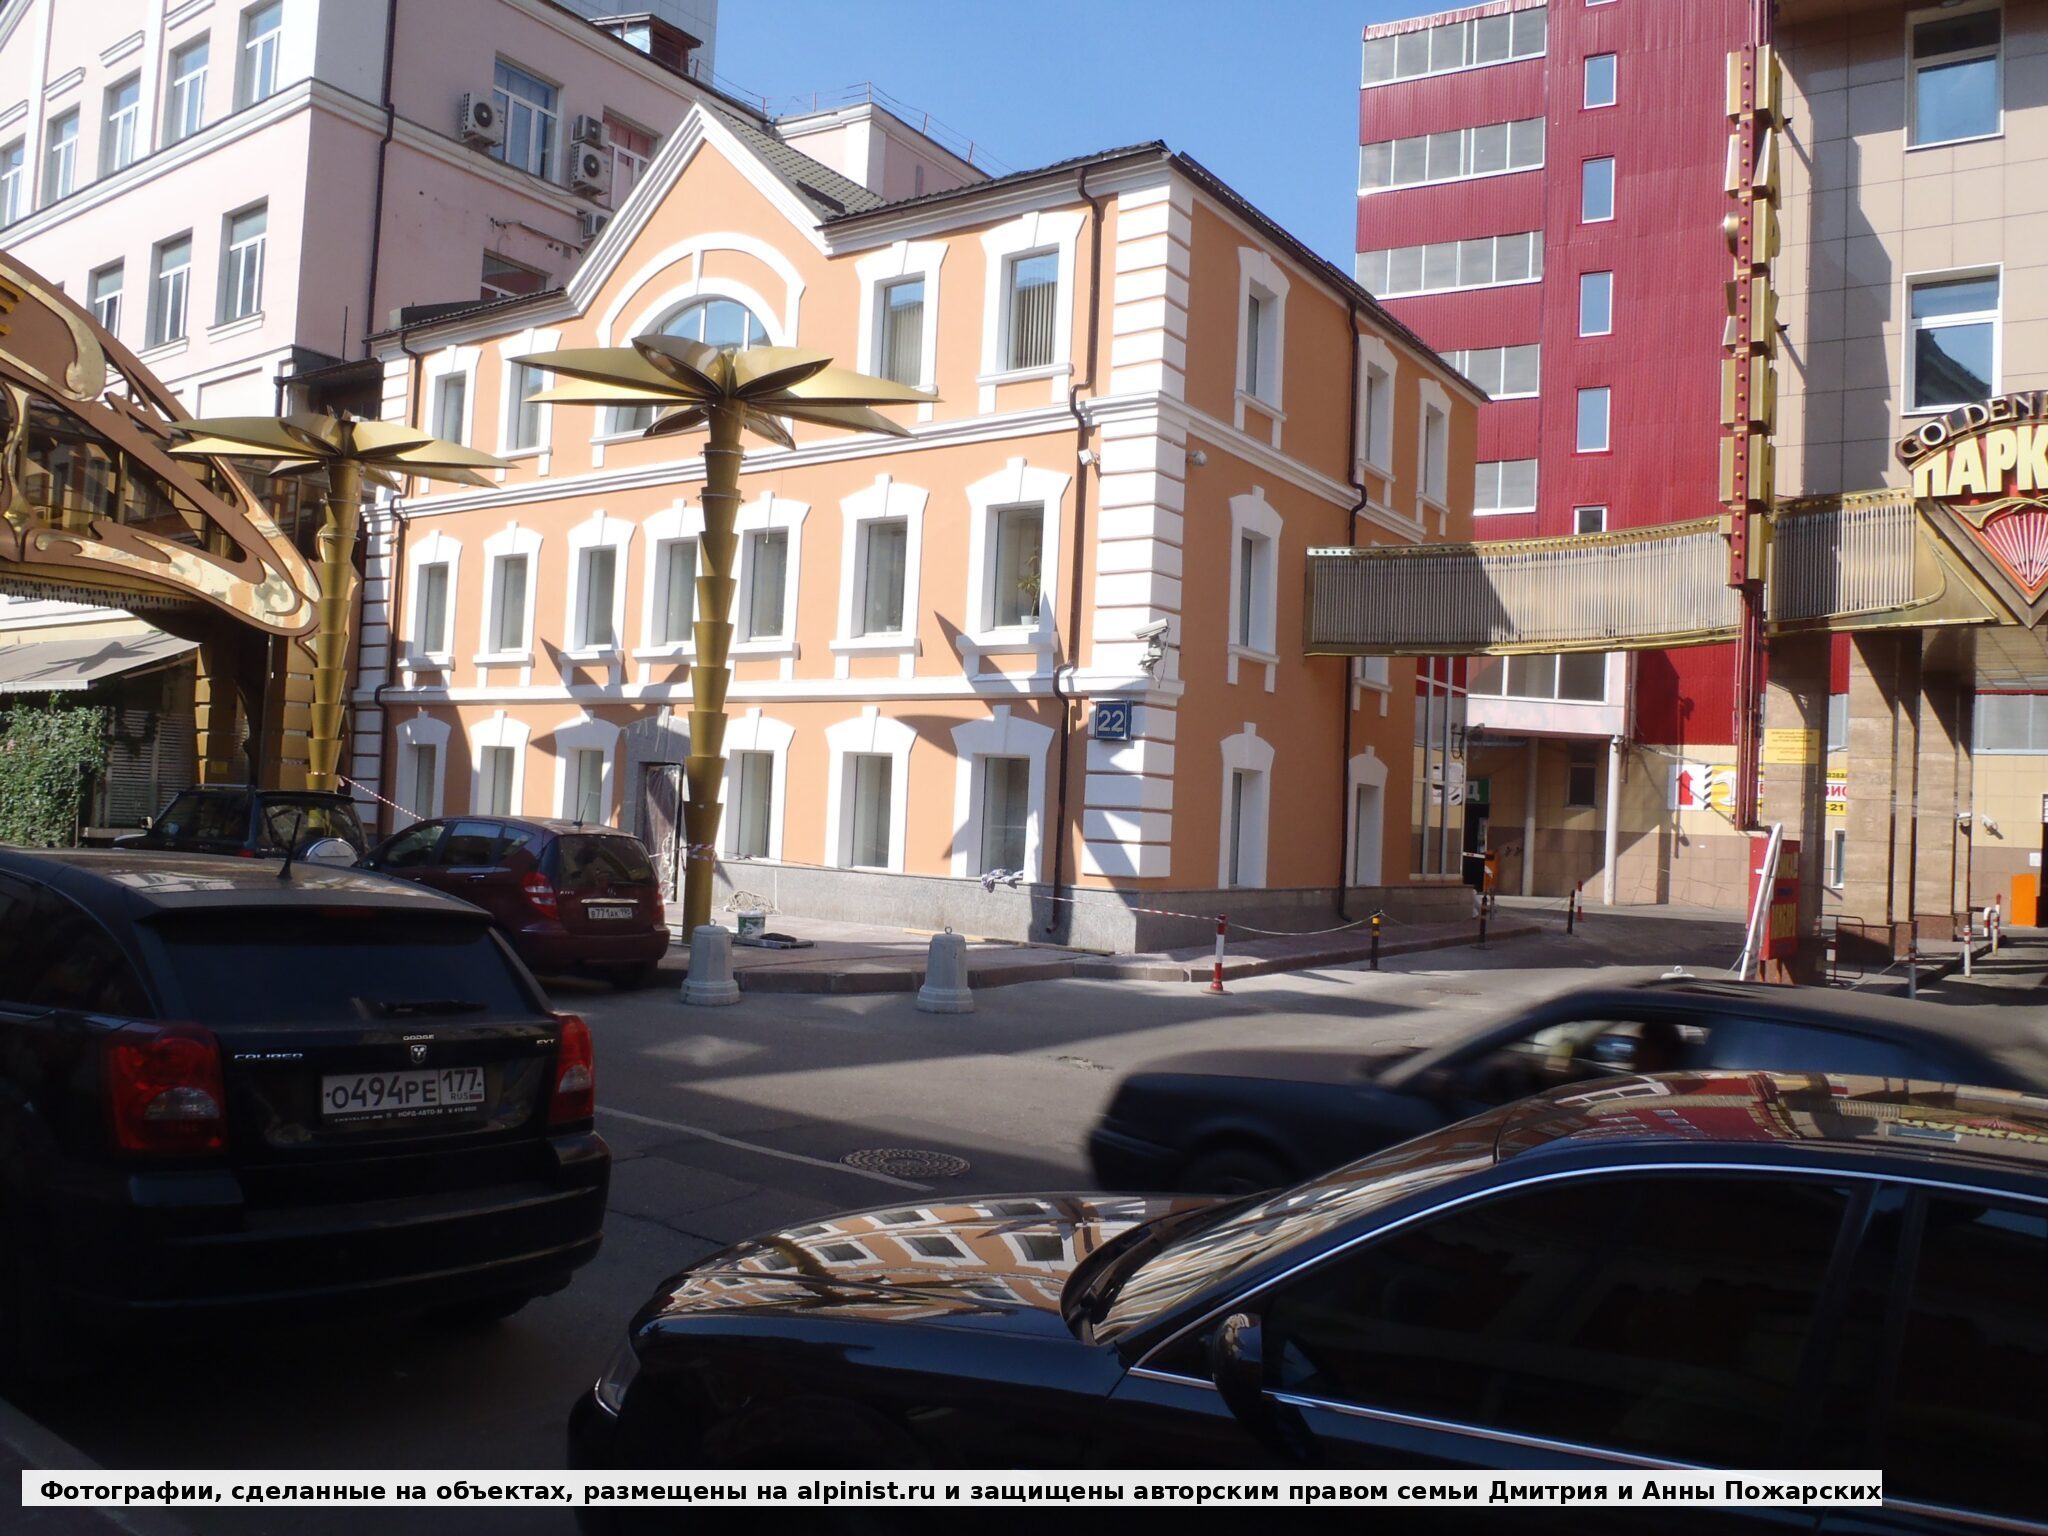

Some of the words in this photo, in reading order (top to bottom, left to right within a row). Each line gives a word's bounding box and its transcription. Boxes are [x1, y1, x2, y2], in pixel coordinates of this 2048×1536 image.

[1900, 392, 2035, 459] GOLDEN
[1098, 710, 1124, 732] 22
[442, 1069, 478, 1092] 177
[451, 1092, 469, 1100] RUS
